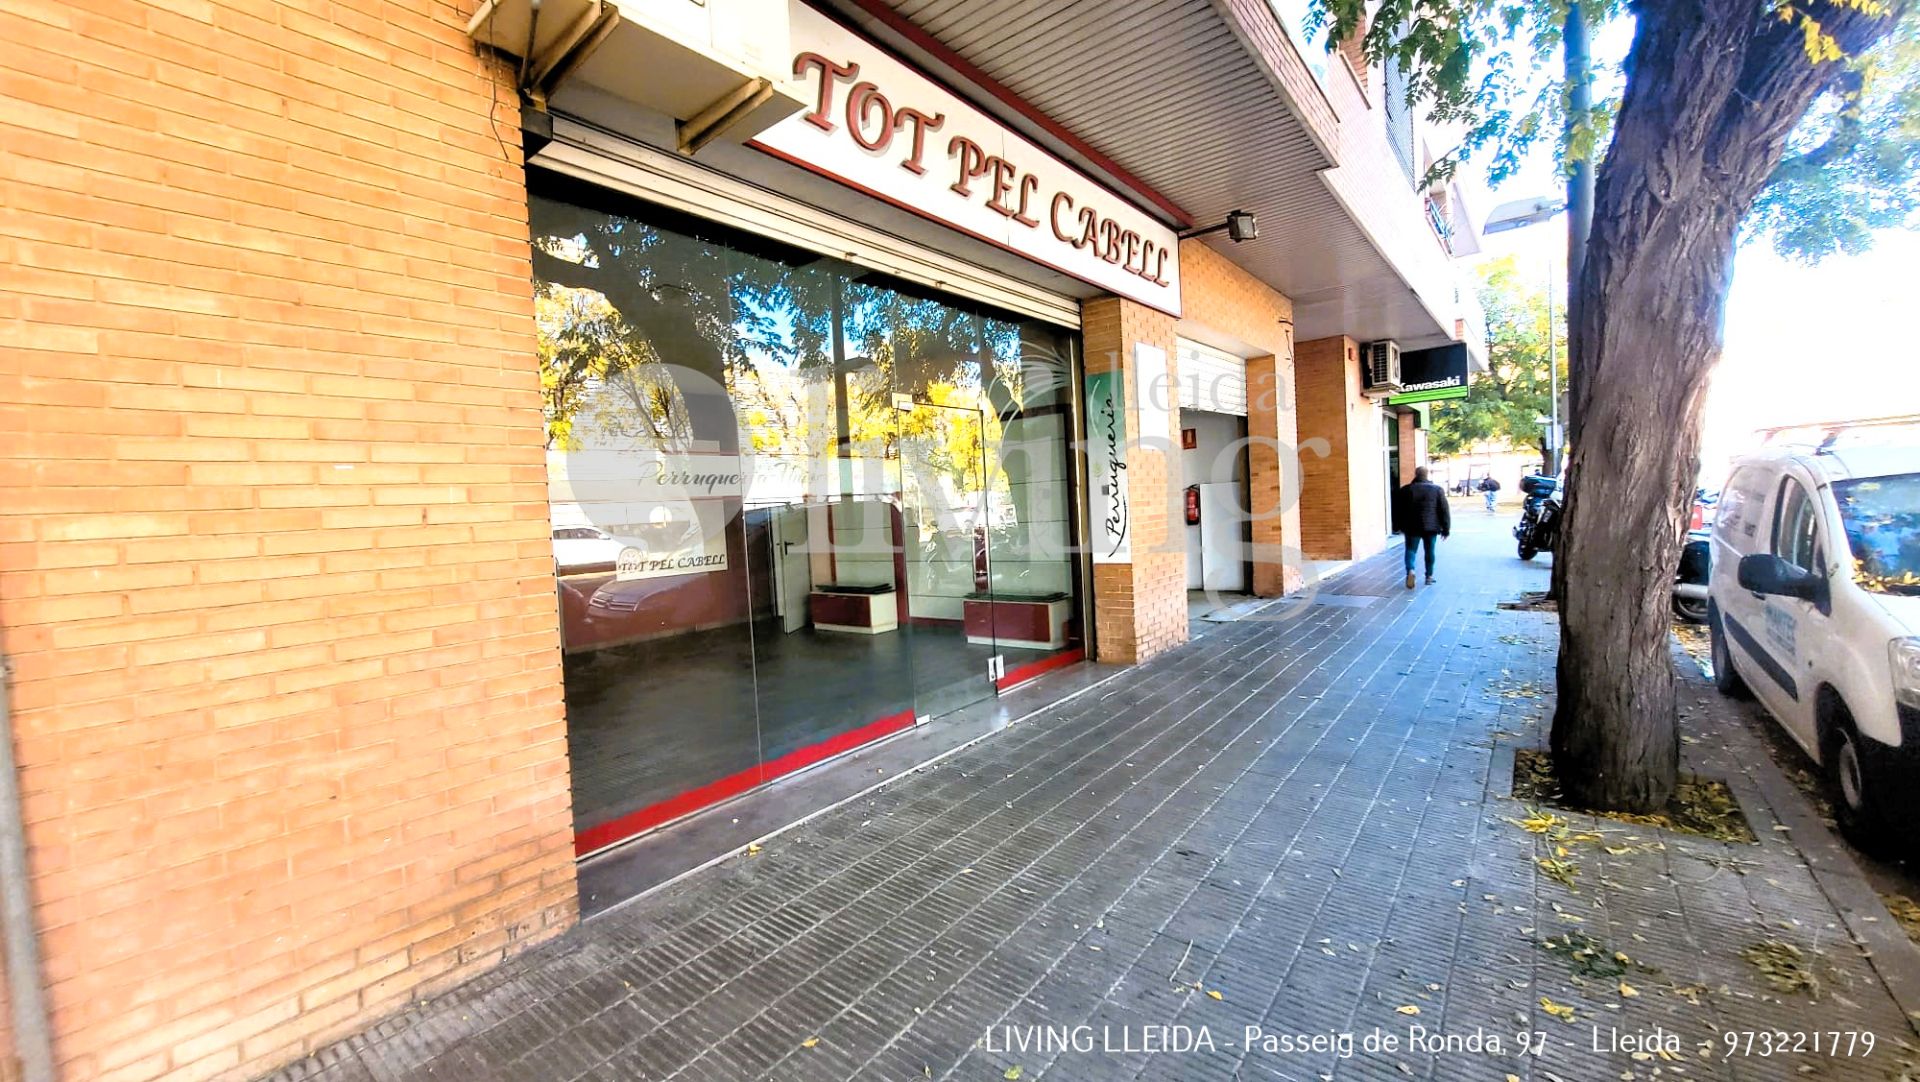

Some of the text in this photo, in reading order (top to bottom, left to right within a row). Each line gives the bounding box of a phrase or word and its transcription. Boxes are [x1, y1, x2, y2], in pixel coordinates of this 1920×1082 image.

[792, 51, 1170, 288] TOT PEL CABELL
[649, 558, 675, 571] PEL
[677, 553, 726, 569] CABELL
